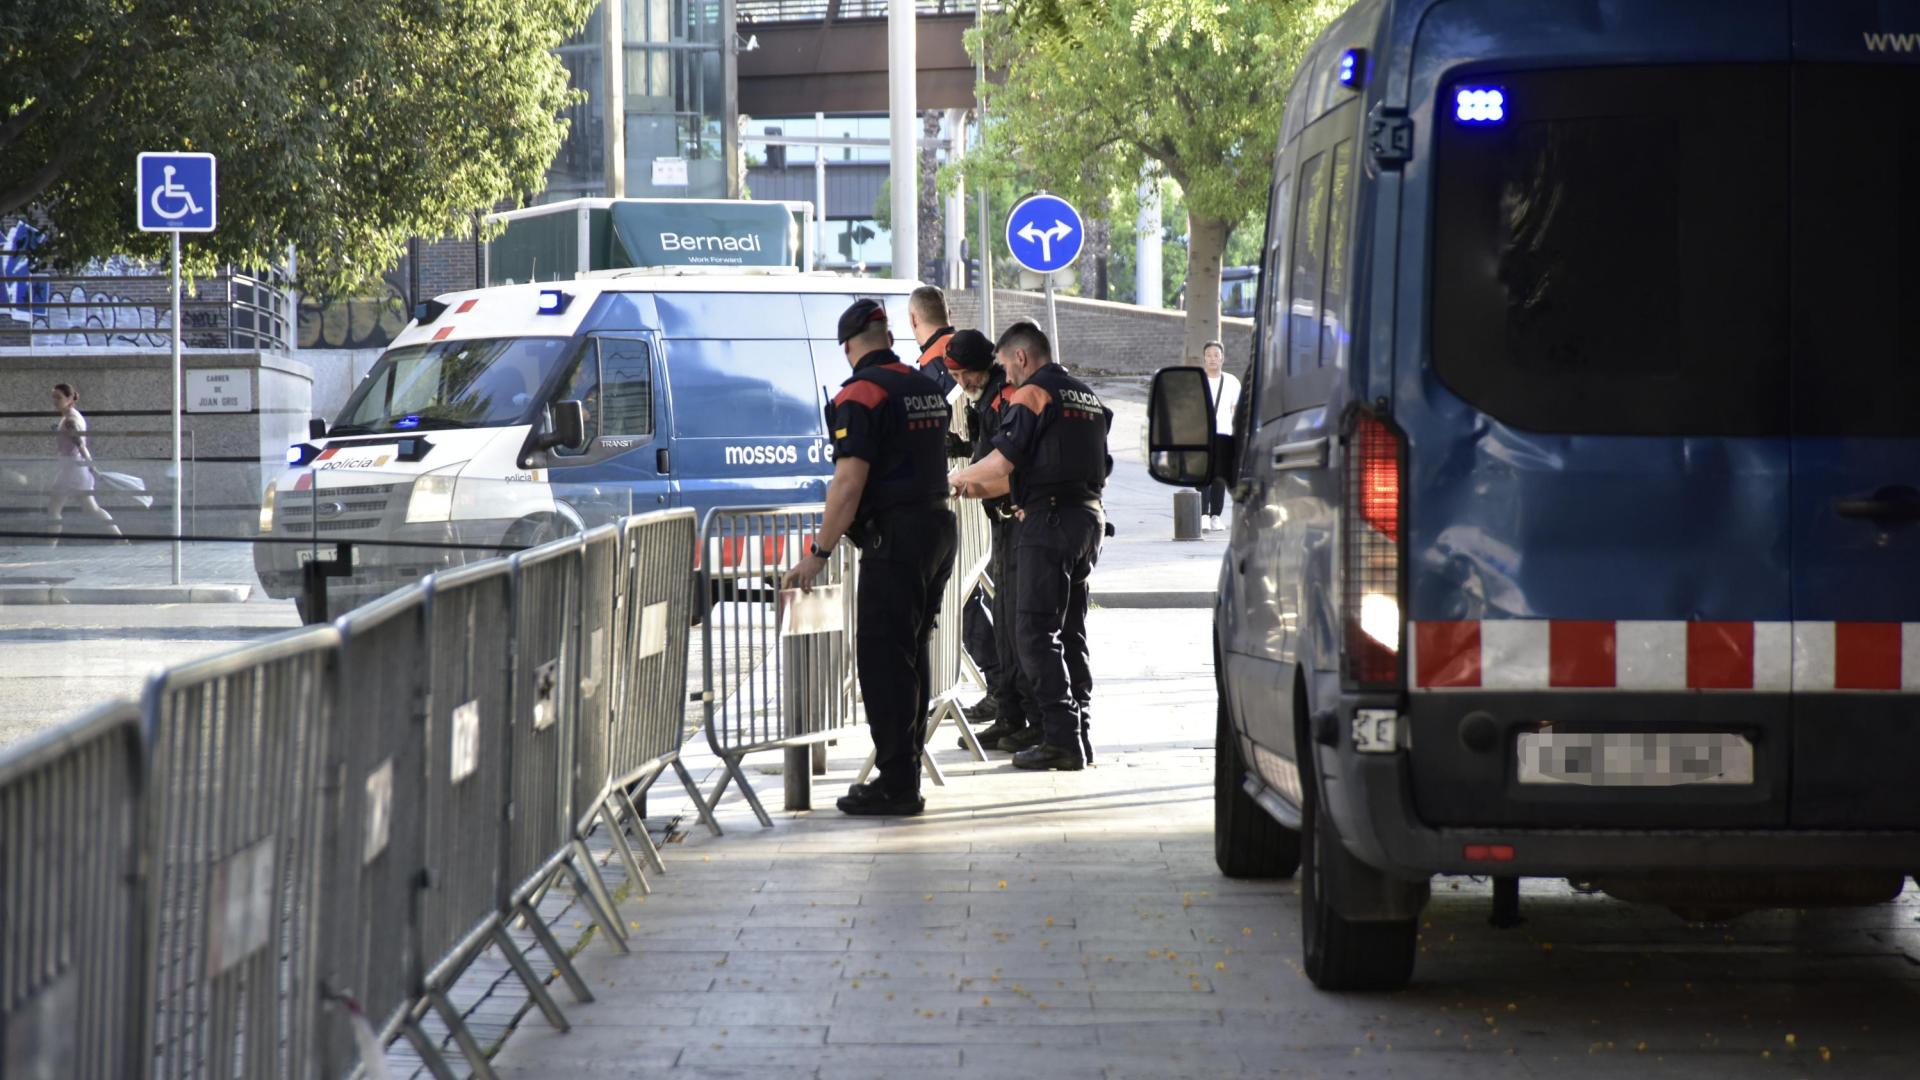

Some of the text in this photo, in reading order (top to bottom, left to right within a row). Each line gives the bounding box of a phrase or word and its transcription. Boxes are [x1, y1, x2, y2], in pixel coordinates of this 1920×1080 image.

[1862, 31, 1920, 52] ww
[688, 256, 743, 264] Work Forward
[601, 439, 633, 448] TRANSIT
[725, 438, 834, 465] mossos d'e
